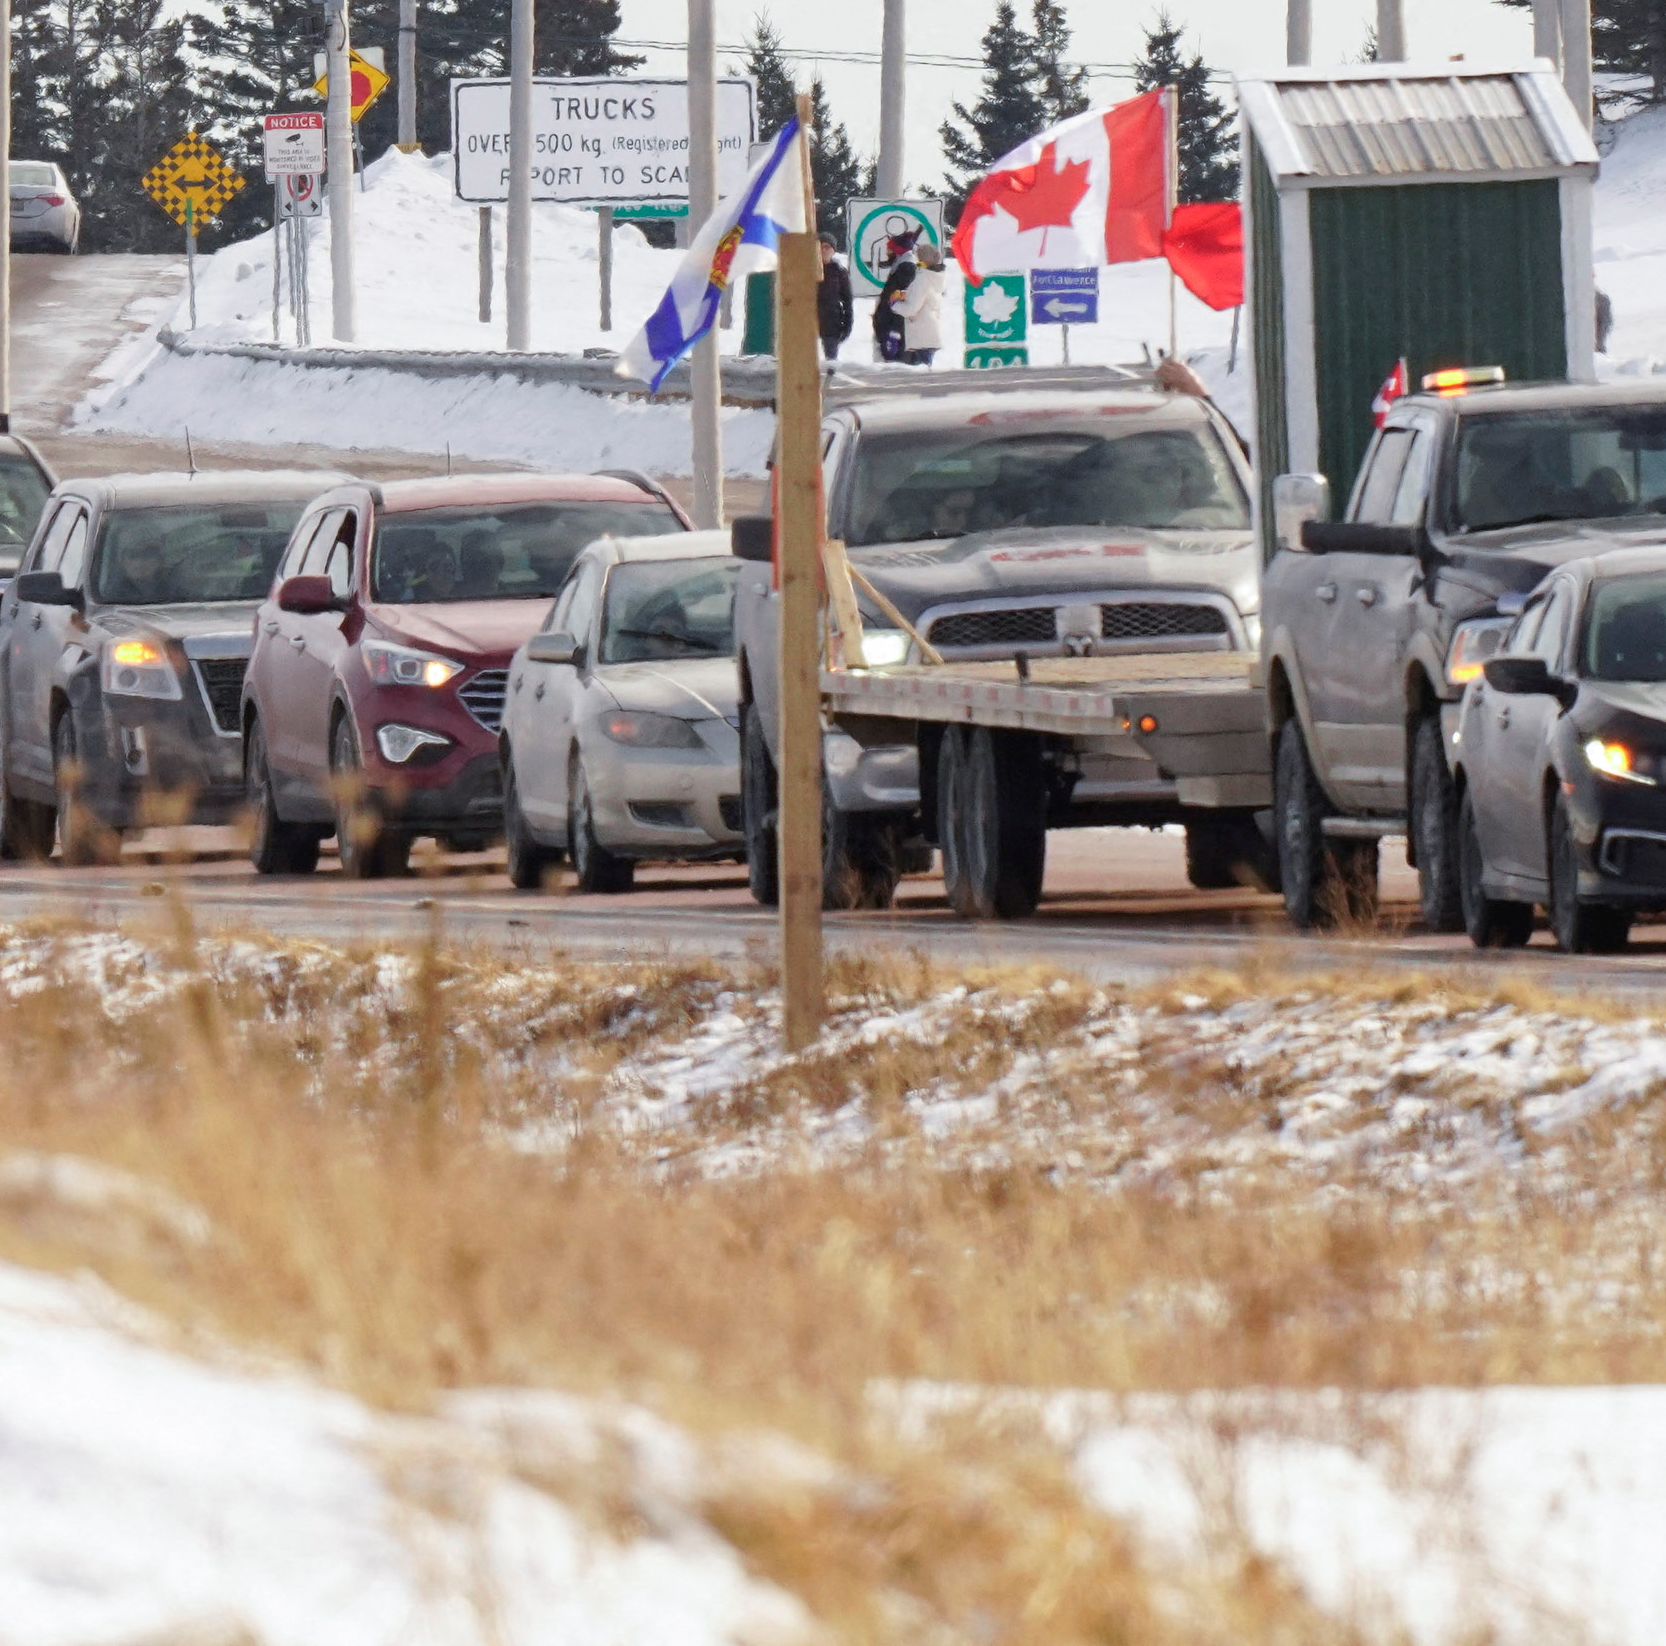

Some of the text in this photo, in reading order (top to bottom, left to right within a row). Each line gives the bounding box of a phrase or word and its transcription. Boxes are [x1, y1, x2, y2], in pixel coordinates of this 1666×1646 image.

[550, 97, 656, 120] TRUCKS
[271, 117, 318, 127] NOTICE
[600, 166, 624, 185] TO
